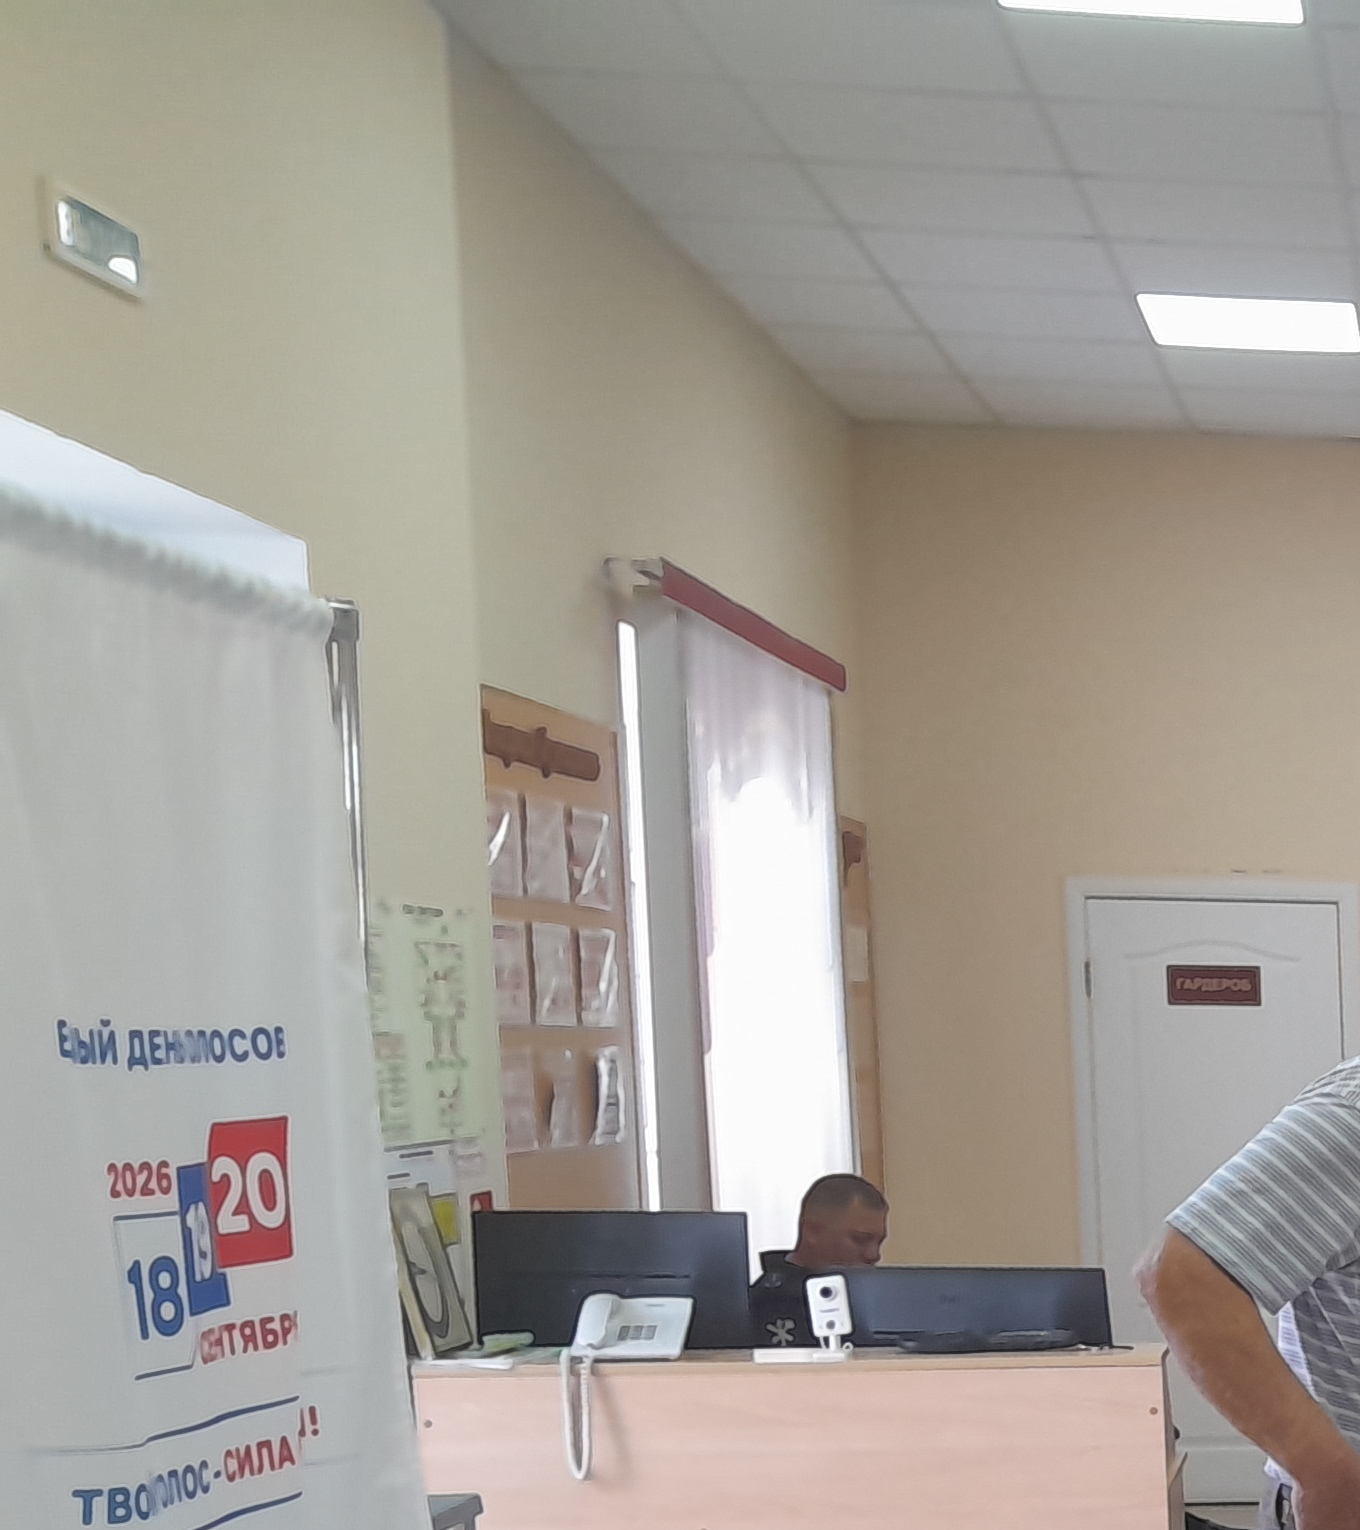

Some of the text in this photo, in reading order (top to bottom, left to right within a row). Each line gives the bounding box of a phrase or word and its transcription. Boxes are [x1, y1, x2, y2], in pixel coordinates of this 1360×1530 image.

[107, 1160, 172, 1199] 2026
[127, 1255, 185, 1341] 18
[211, 1151, 286, 1234] 20
[71, 1482, 150, 1526] ТВО
[223, 1435, 296, 1483] СИЛА
